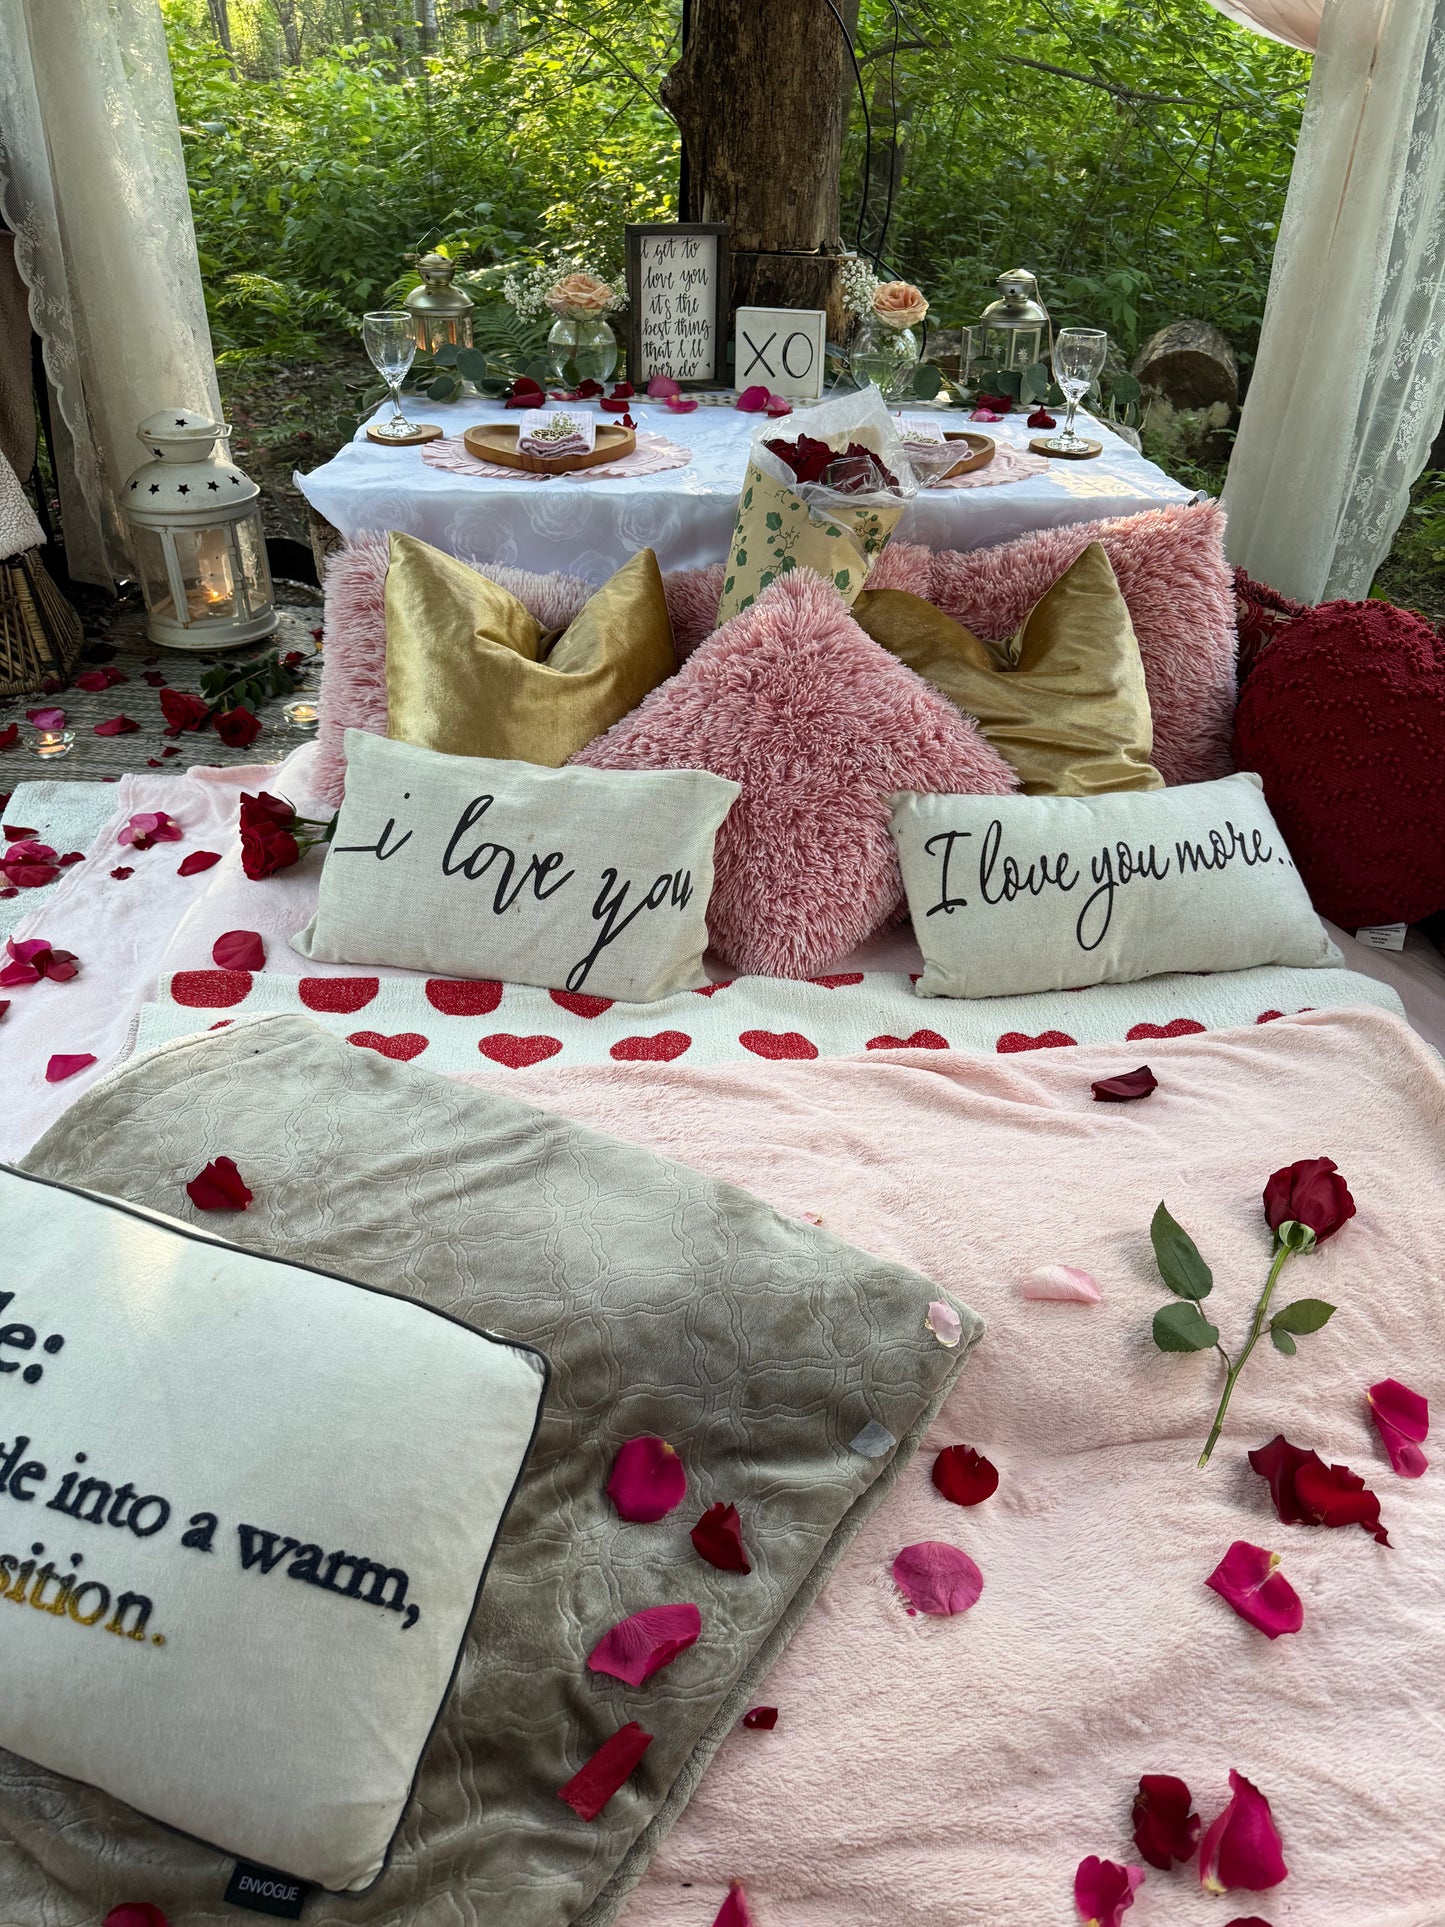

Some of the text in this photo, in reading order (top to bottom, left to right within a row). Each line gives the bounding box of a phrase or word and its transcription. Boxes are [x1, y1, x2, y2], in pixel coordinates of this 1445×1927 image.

[653, 238, 678, 265] get
[681, 238, 701, 258] to
[643, 266, 709, 292] love you
[676, 293, 699, 317] the
[643, 318, 712, 340] best thing
[643, 340, 675, 361] that
[742, 331, 814, 379] XO
[647, 359, 699, 379] ever do
[442, 794, 575, 915] love
[566, 867, 694, 992] you
[924, 829, 972, 917] I
[979, 819, 1080, 905] love
[1076, 841, 1171, 951] you
[46, 1452, 171, 1537] into
[181, 1511, 219, 1553] a
[238, 1523, 420, 1630] warm,
[238, 1875, 301, 1901] ENVOGUE
